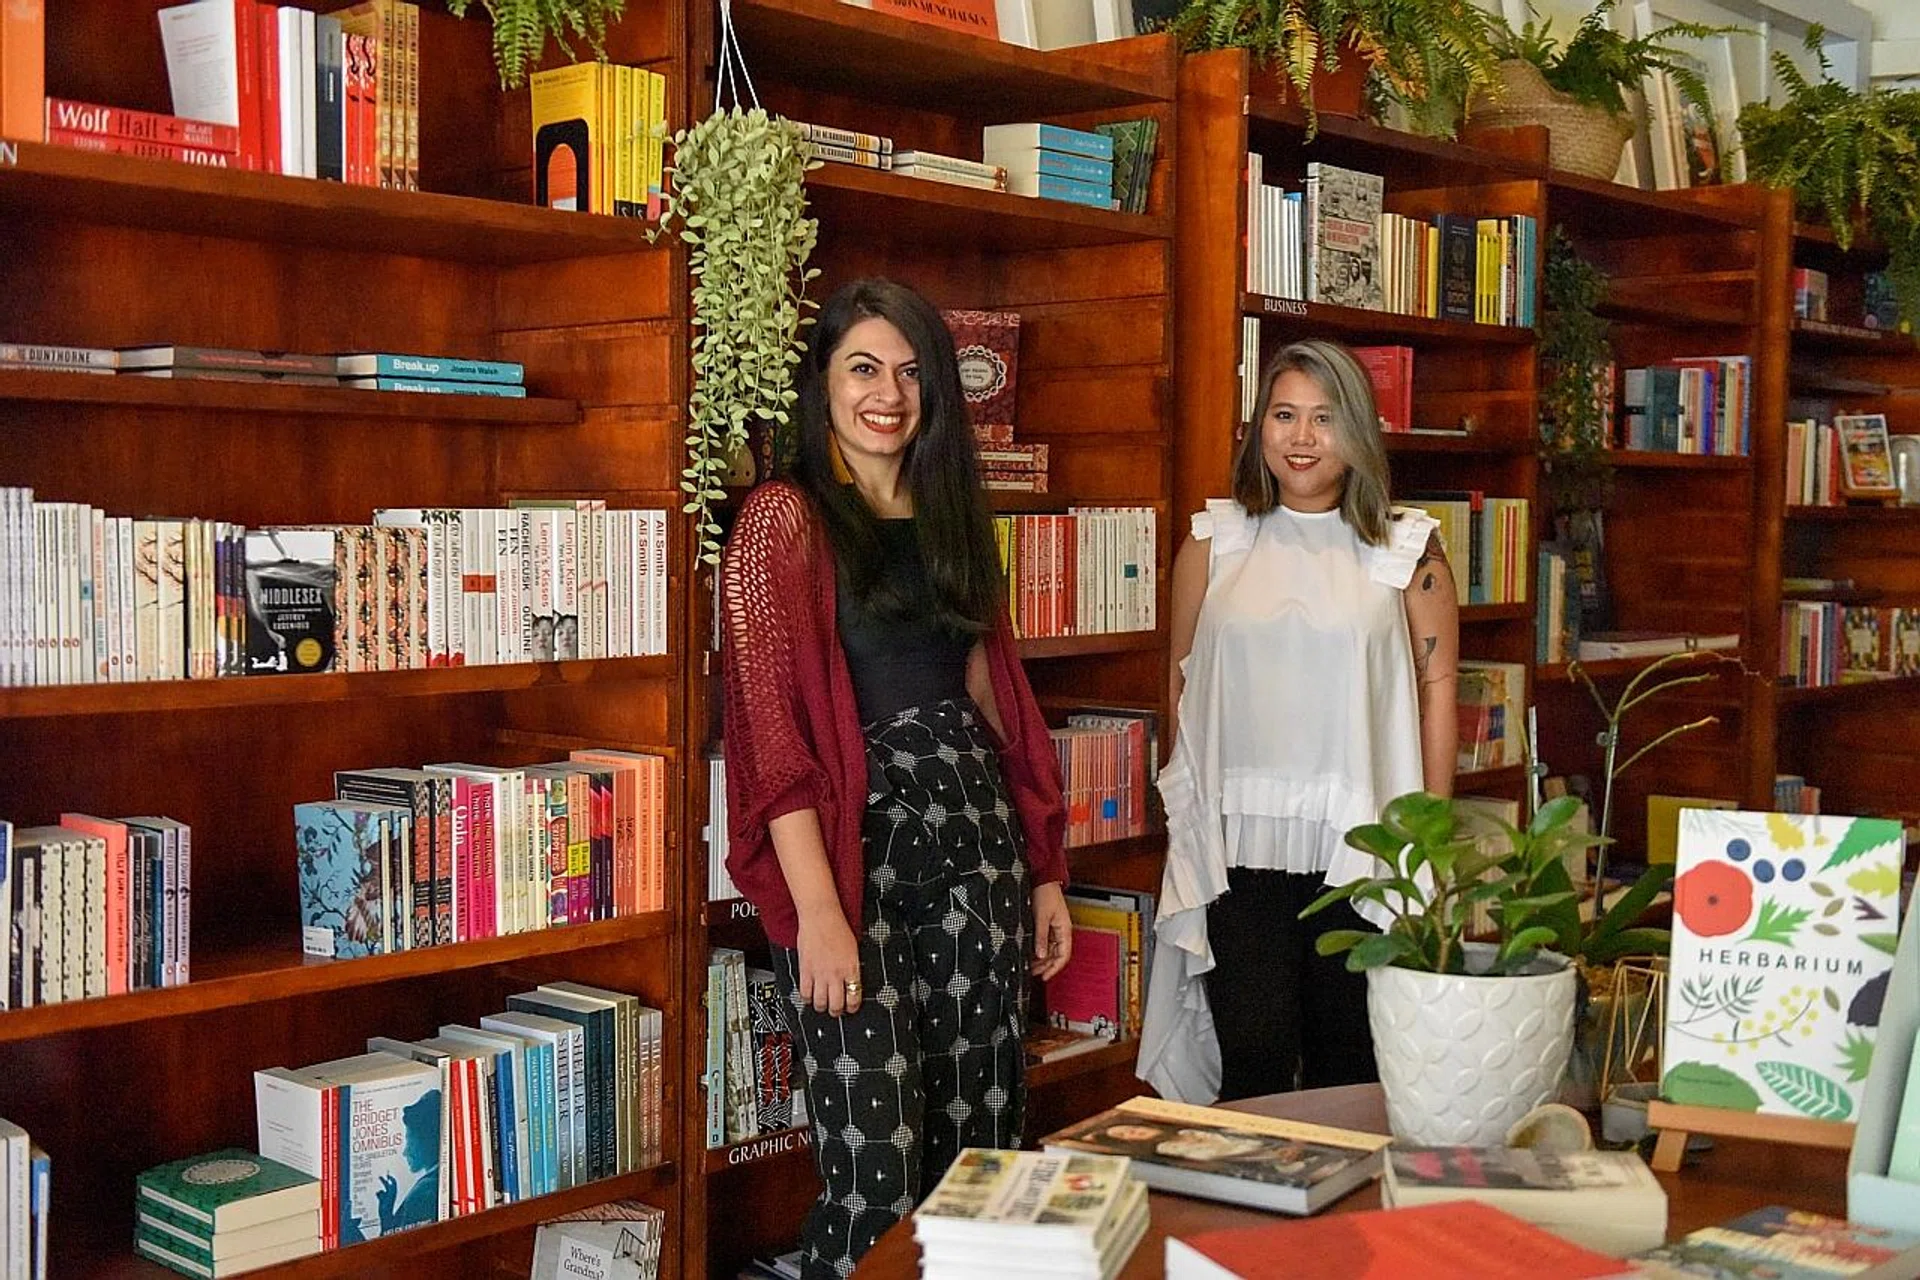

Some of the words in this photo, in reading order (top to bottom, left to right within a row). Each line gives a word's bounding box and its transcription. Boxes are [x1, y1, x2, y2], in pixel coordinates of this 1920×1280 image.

[58, 103, 110, 133] Wolf
[118, 113, 157, 138] Hall
[1264, 298, 1308, 315] BUSINESS
[510, 528, 519, 554] FEN
[639, 519, 647, 535] Ali
[656, 520, 664, 536] Ali
[498, 529, 507, 556] FEN
[540, 522, 550, 564] Lenin's
[565, 522, 574, 564] Lenin's
[639, 538, 647, 576] Smith
[656, 540, 664, 577] Smith
[260, 588, 322, 605] MIDDLESEX
[541, 570, 550, 607] Kisses
[566, 568, 575, 606] Kisses
[522, 606, 531, 654] OUTLINE
[473, 822, 481, 838] the
[485, 821, 493, 836] the
[551, 824, 559, 851] SKIPPY
[581, 846, 589, 872] Back
[581, 877, 589, 898] Talk
[1699, 948, 1863, 975] HERBARIUM
[641, 1041, 650, 1073] LILA
[652, 1038, 661, 1072] LILA
[558, 1038, 569, 1122] SHELTER
[574, 1034, 585, 1116] SHELTER
[352, 1098, 373, 1113] THE
[591, 1081, 599, 1115] SHAPE
[606, 1079, 614, 1114] SHAPE
[353, 1107, 398, 1128] BRIDGET
[353, 1123, 388, 1141] JONES
[353, 1132, 402, 1153] OMNIBUS
[592, 1130, 600, 1167] WATER
[606, 1127, 614, 1164] WATER
[729, 1134, 794, 1165] GRAPHIC
[571, 1246, 601, 1267] Where's
